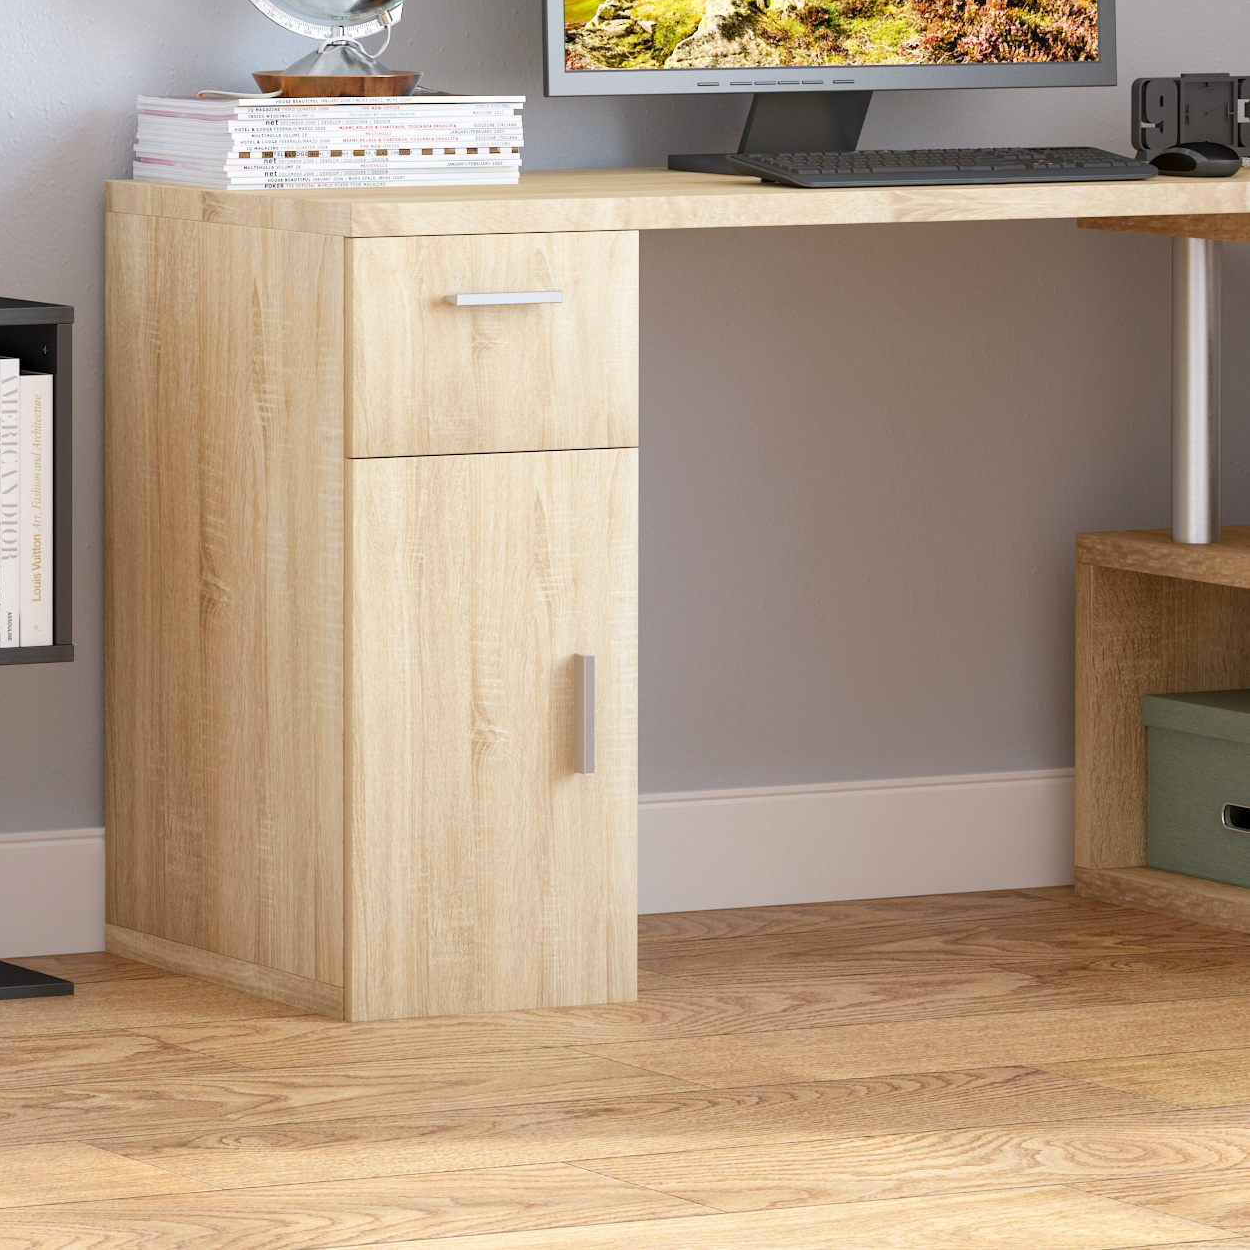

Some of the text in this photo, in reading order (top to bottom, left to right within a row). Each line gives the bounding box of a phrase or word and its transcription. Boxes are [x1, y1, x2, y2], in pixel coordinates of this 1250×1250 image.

[1, 503, 18, 561] DIOR
[31, 533, 42, 602] Louis Vuitton
